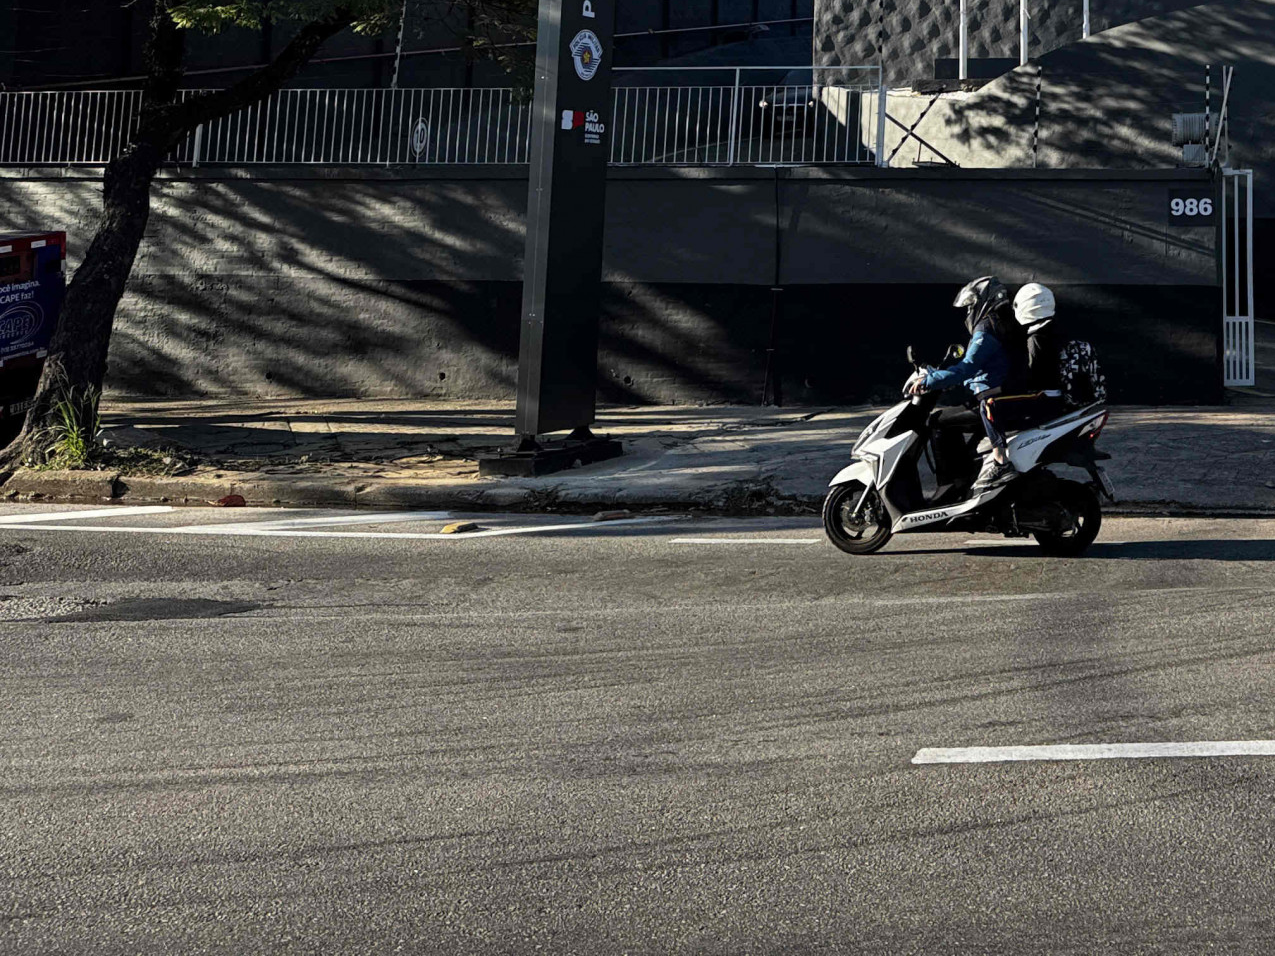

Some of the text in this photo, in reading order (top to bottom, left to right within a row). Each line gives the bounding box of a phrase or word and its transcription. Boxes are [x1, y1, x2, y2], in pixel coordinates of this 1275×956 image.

[585, 110, 599, 122] SÃO
[584, 122, 605, 134] PAULO
[1170, 198, 1213, 216] 986
[910, 511, 949, 523] HONDA
